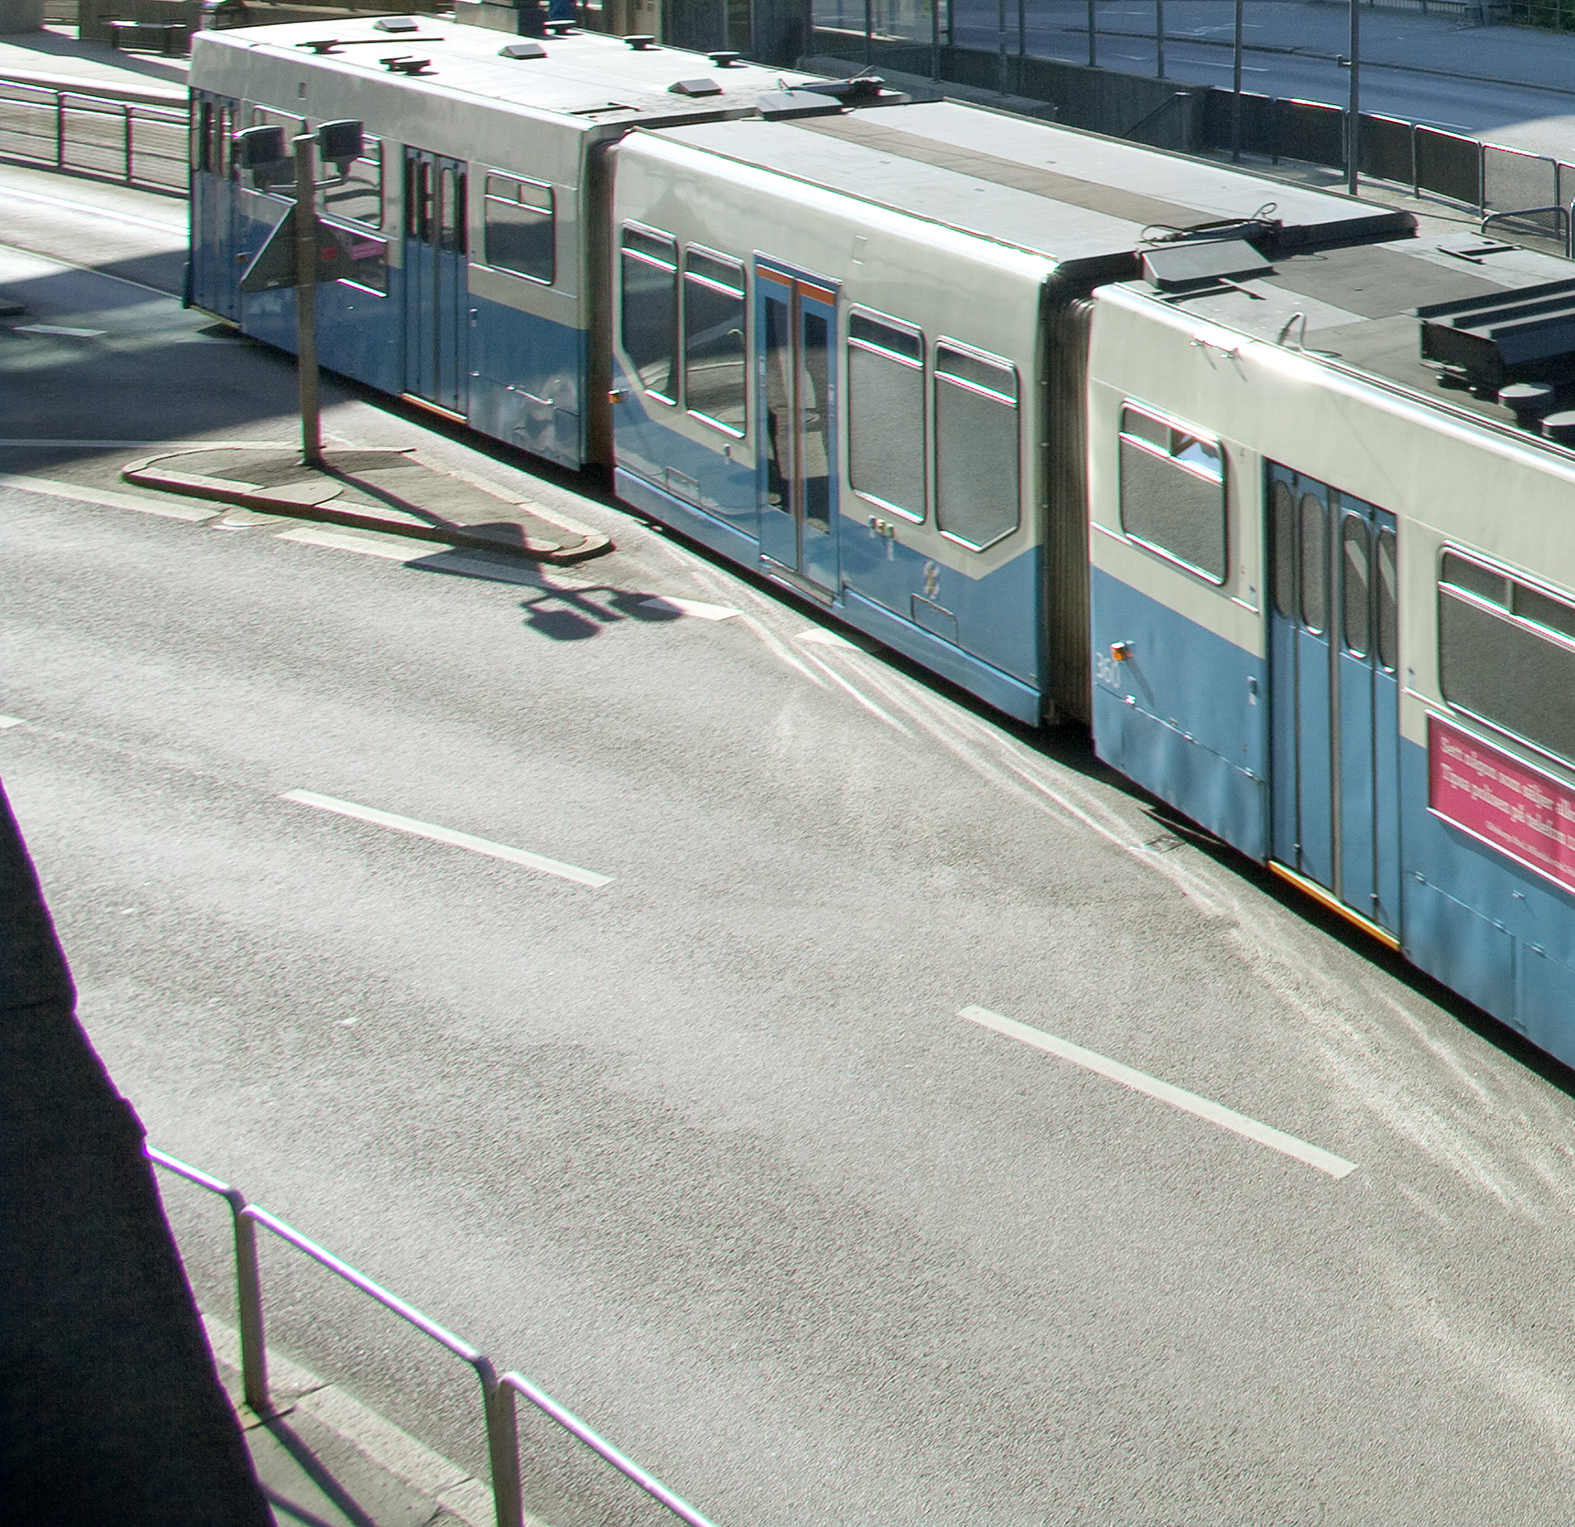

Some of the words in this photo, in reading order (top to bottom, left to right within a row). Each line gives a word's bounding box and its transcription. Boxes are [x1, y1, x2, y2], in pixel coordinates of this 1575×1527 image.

[1095, 651, 1121, 689] 360
[1440, 761, 1470, 793] Tipsa
[1470, 783, 1511, 815] polisen
[1524, 813, 1566, 845] telefon
[1463, 750, 1498, 781] någon
[1498, 771, 1521, 794] som
[1521, 783, 1555, 811] säljer
